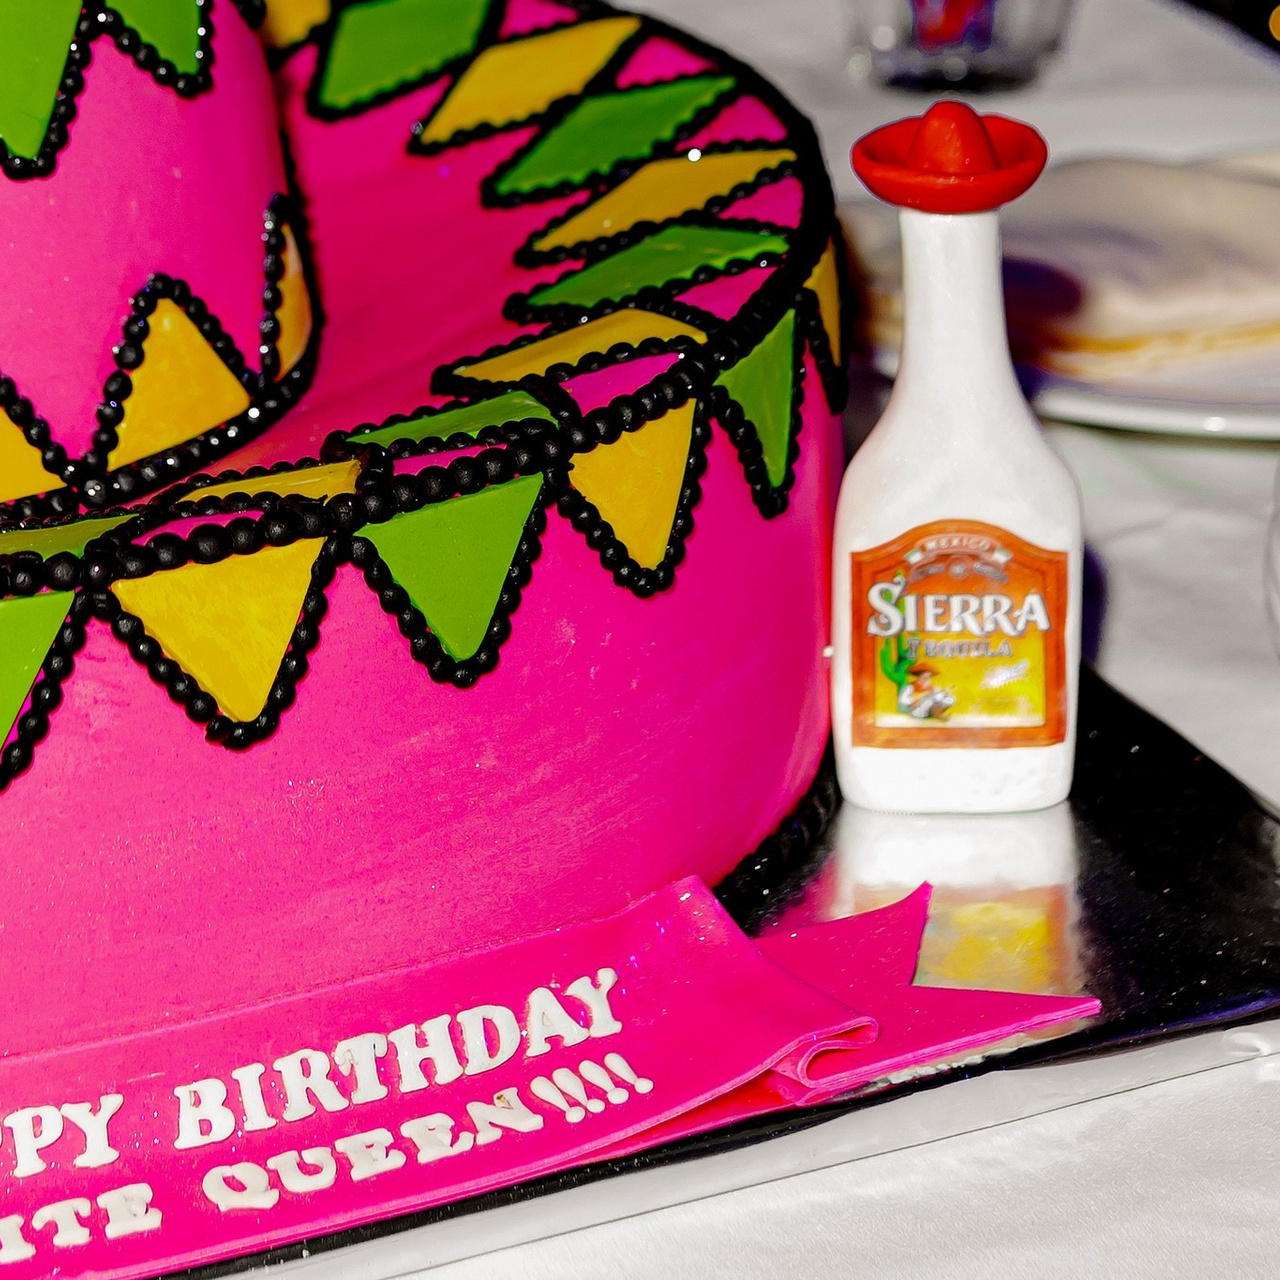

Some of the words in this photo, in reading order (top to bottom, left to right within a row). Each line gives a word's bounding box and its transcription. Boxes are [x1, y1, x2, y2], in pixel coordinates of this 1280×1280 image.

[867, 575, 1051, 637] SIERRA
[173, 967, 623, 1150] BIRTHDAY
[202, 1052, 654, 1212] QUEEN!!!!
